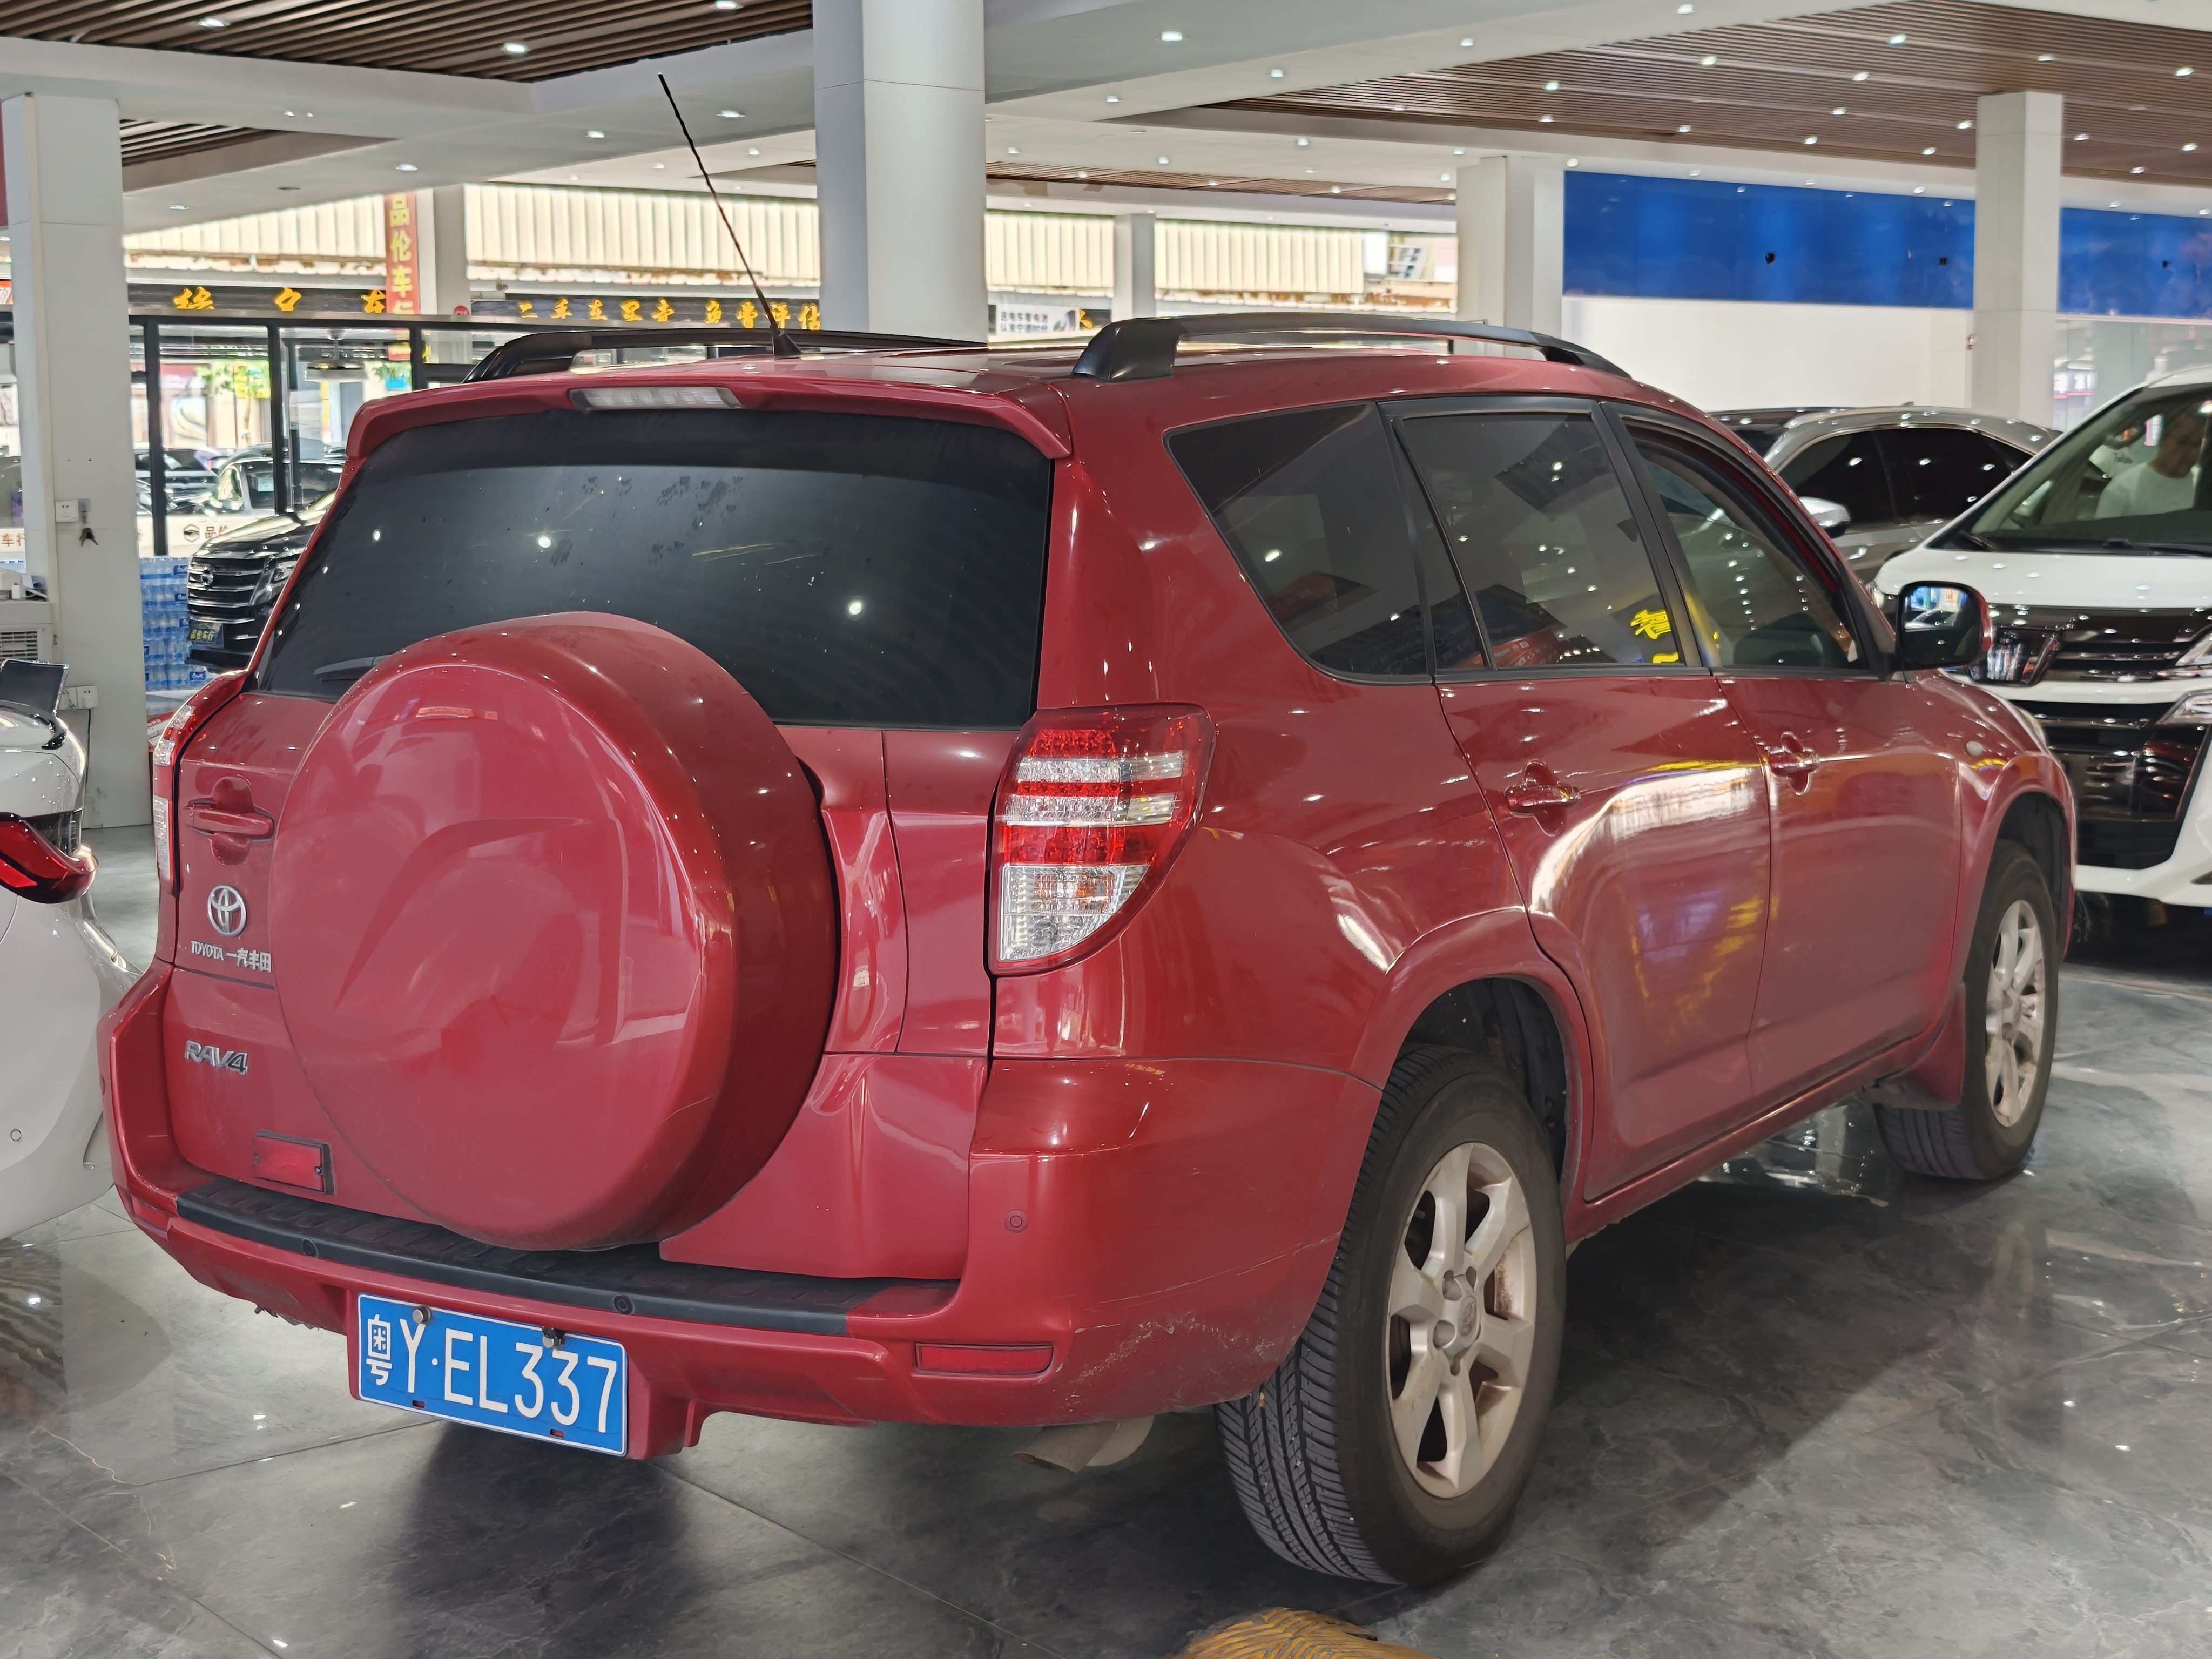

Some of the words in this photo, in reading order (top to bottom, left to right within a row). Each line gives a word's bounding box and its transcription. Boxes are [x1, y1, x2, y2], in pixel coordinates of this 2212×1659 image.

[191, 941, 224, 961] TOYOTA
[226, 947, 272, 973] 一汽丰田
[184, 1039, 248, 1076] RAV4
